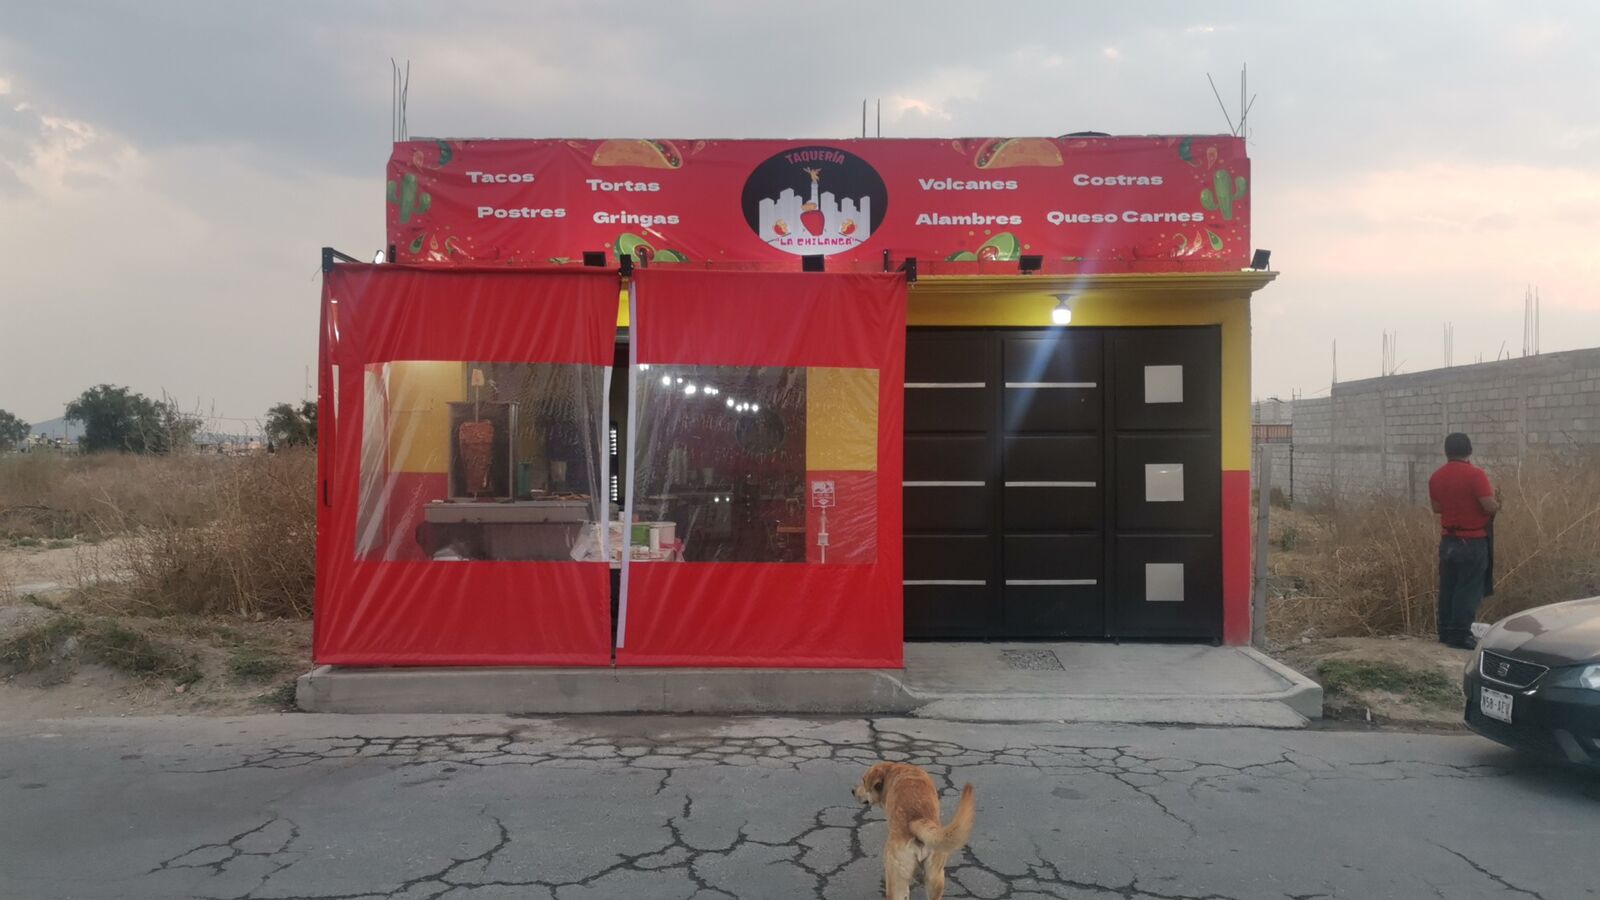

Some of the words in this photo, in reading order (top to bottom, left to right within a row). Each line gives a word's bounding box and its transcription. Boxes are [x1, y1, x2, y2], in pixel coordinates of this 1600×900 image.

[785, 150, 845, 165] TAQUERÍA
[466, 171, 534, 183] Tacos
[1073, 173, 1163, 187] Costras
[586, 179, 660, 192] Tortas
[919, 178, 1018, 191] Volcanes
[478, 206, 566, 219] Postres
[593, 211, 680, 227] Gringas
[1047, 211, 1118, 226] Queso
[1122, 211, 1204, 223] Carnes
[915, 213, 1022, 226] Alambres
